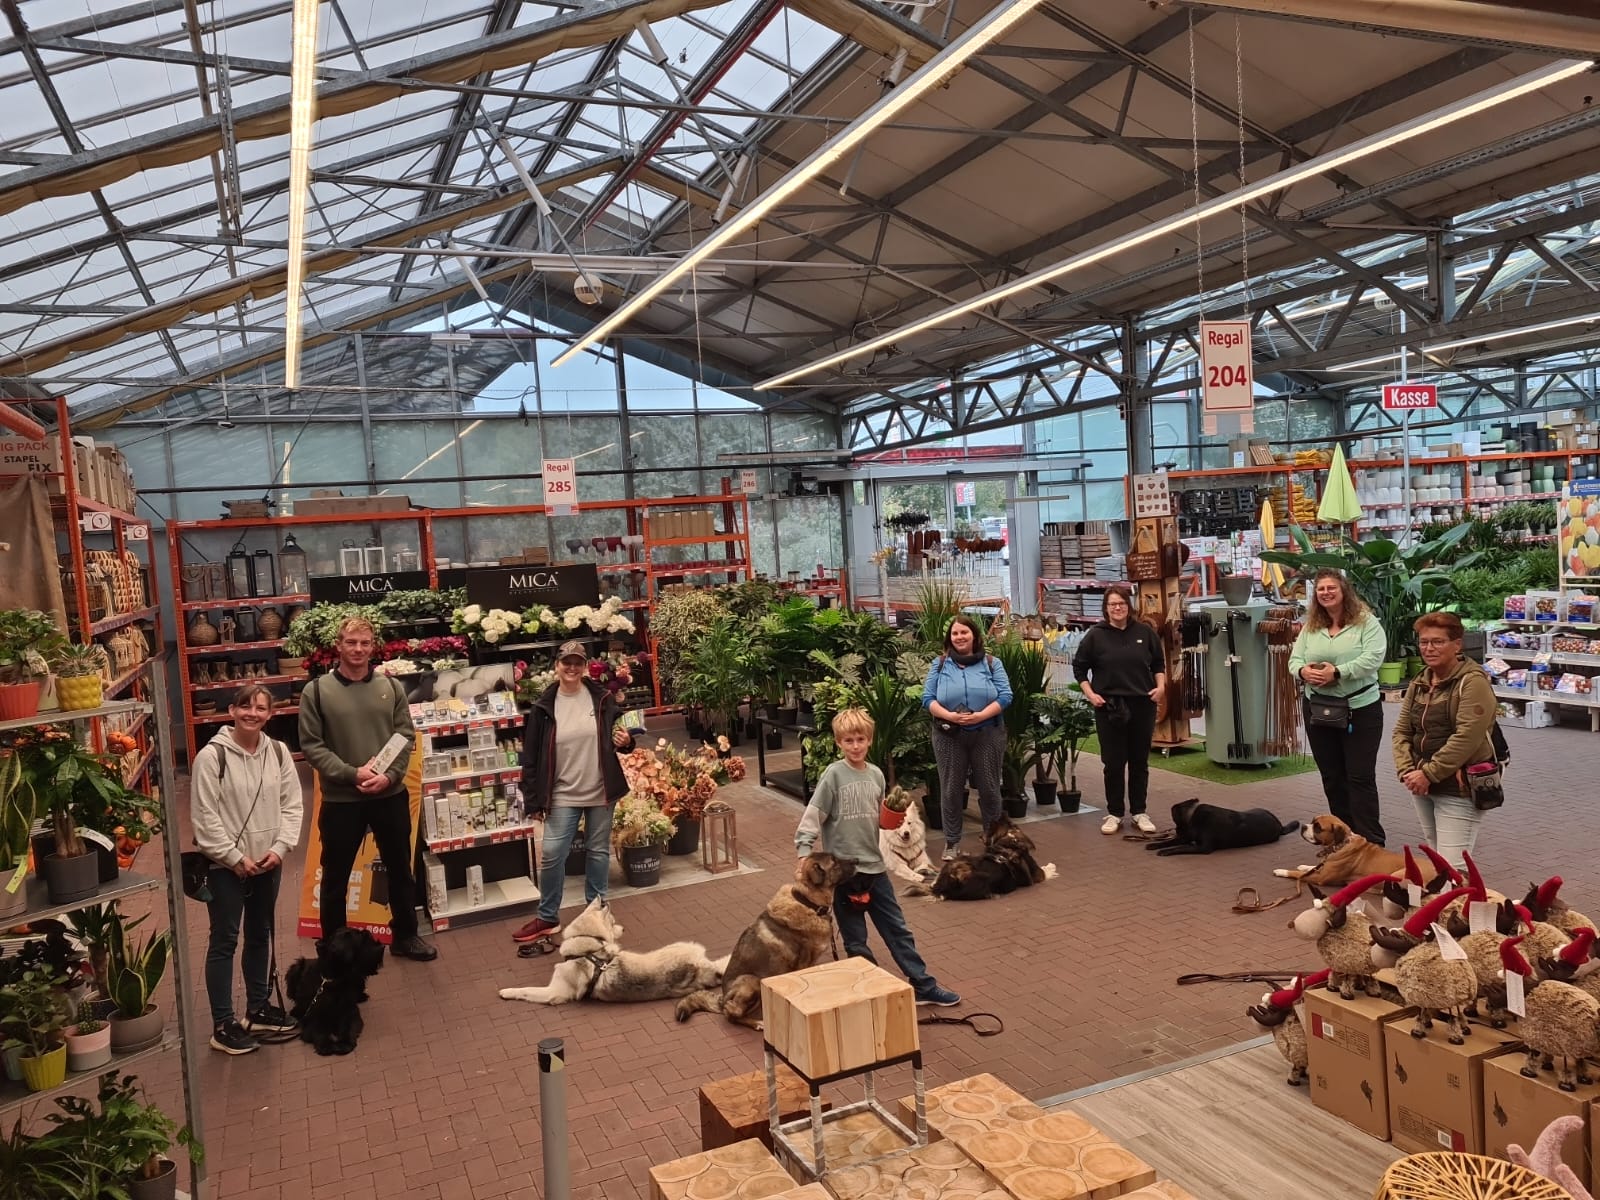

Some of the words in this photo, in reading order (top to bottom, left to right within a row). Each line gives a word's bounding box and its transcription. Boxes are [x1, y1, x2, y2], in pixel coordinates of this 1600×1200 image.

[1208, 329, 1243, 348] Regal
[1208, 365, 1247, 387] 204
[1390, 388, 1430, 406] Kasse
[0, 443, 13, 452] IG
[17, 441, 49, 452] PACK
[4, 455, 40, 464] STAPEL
[28, 463, 52, 473] FIX
[546, 463, 570, 473] Regal
[547, 481, 572, 493] 285
[311, 883, 362, 911] SE
